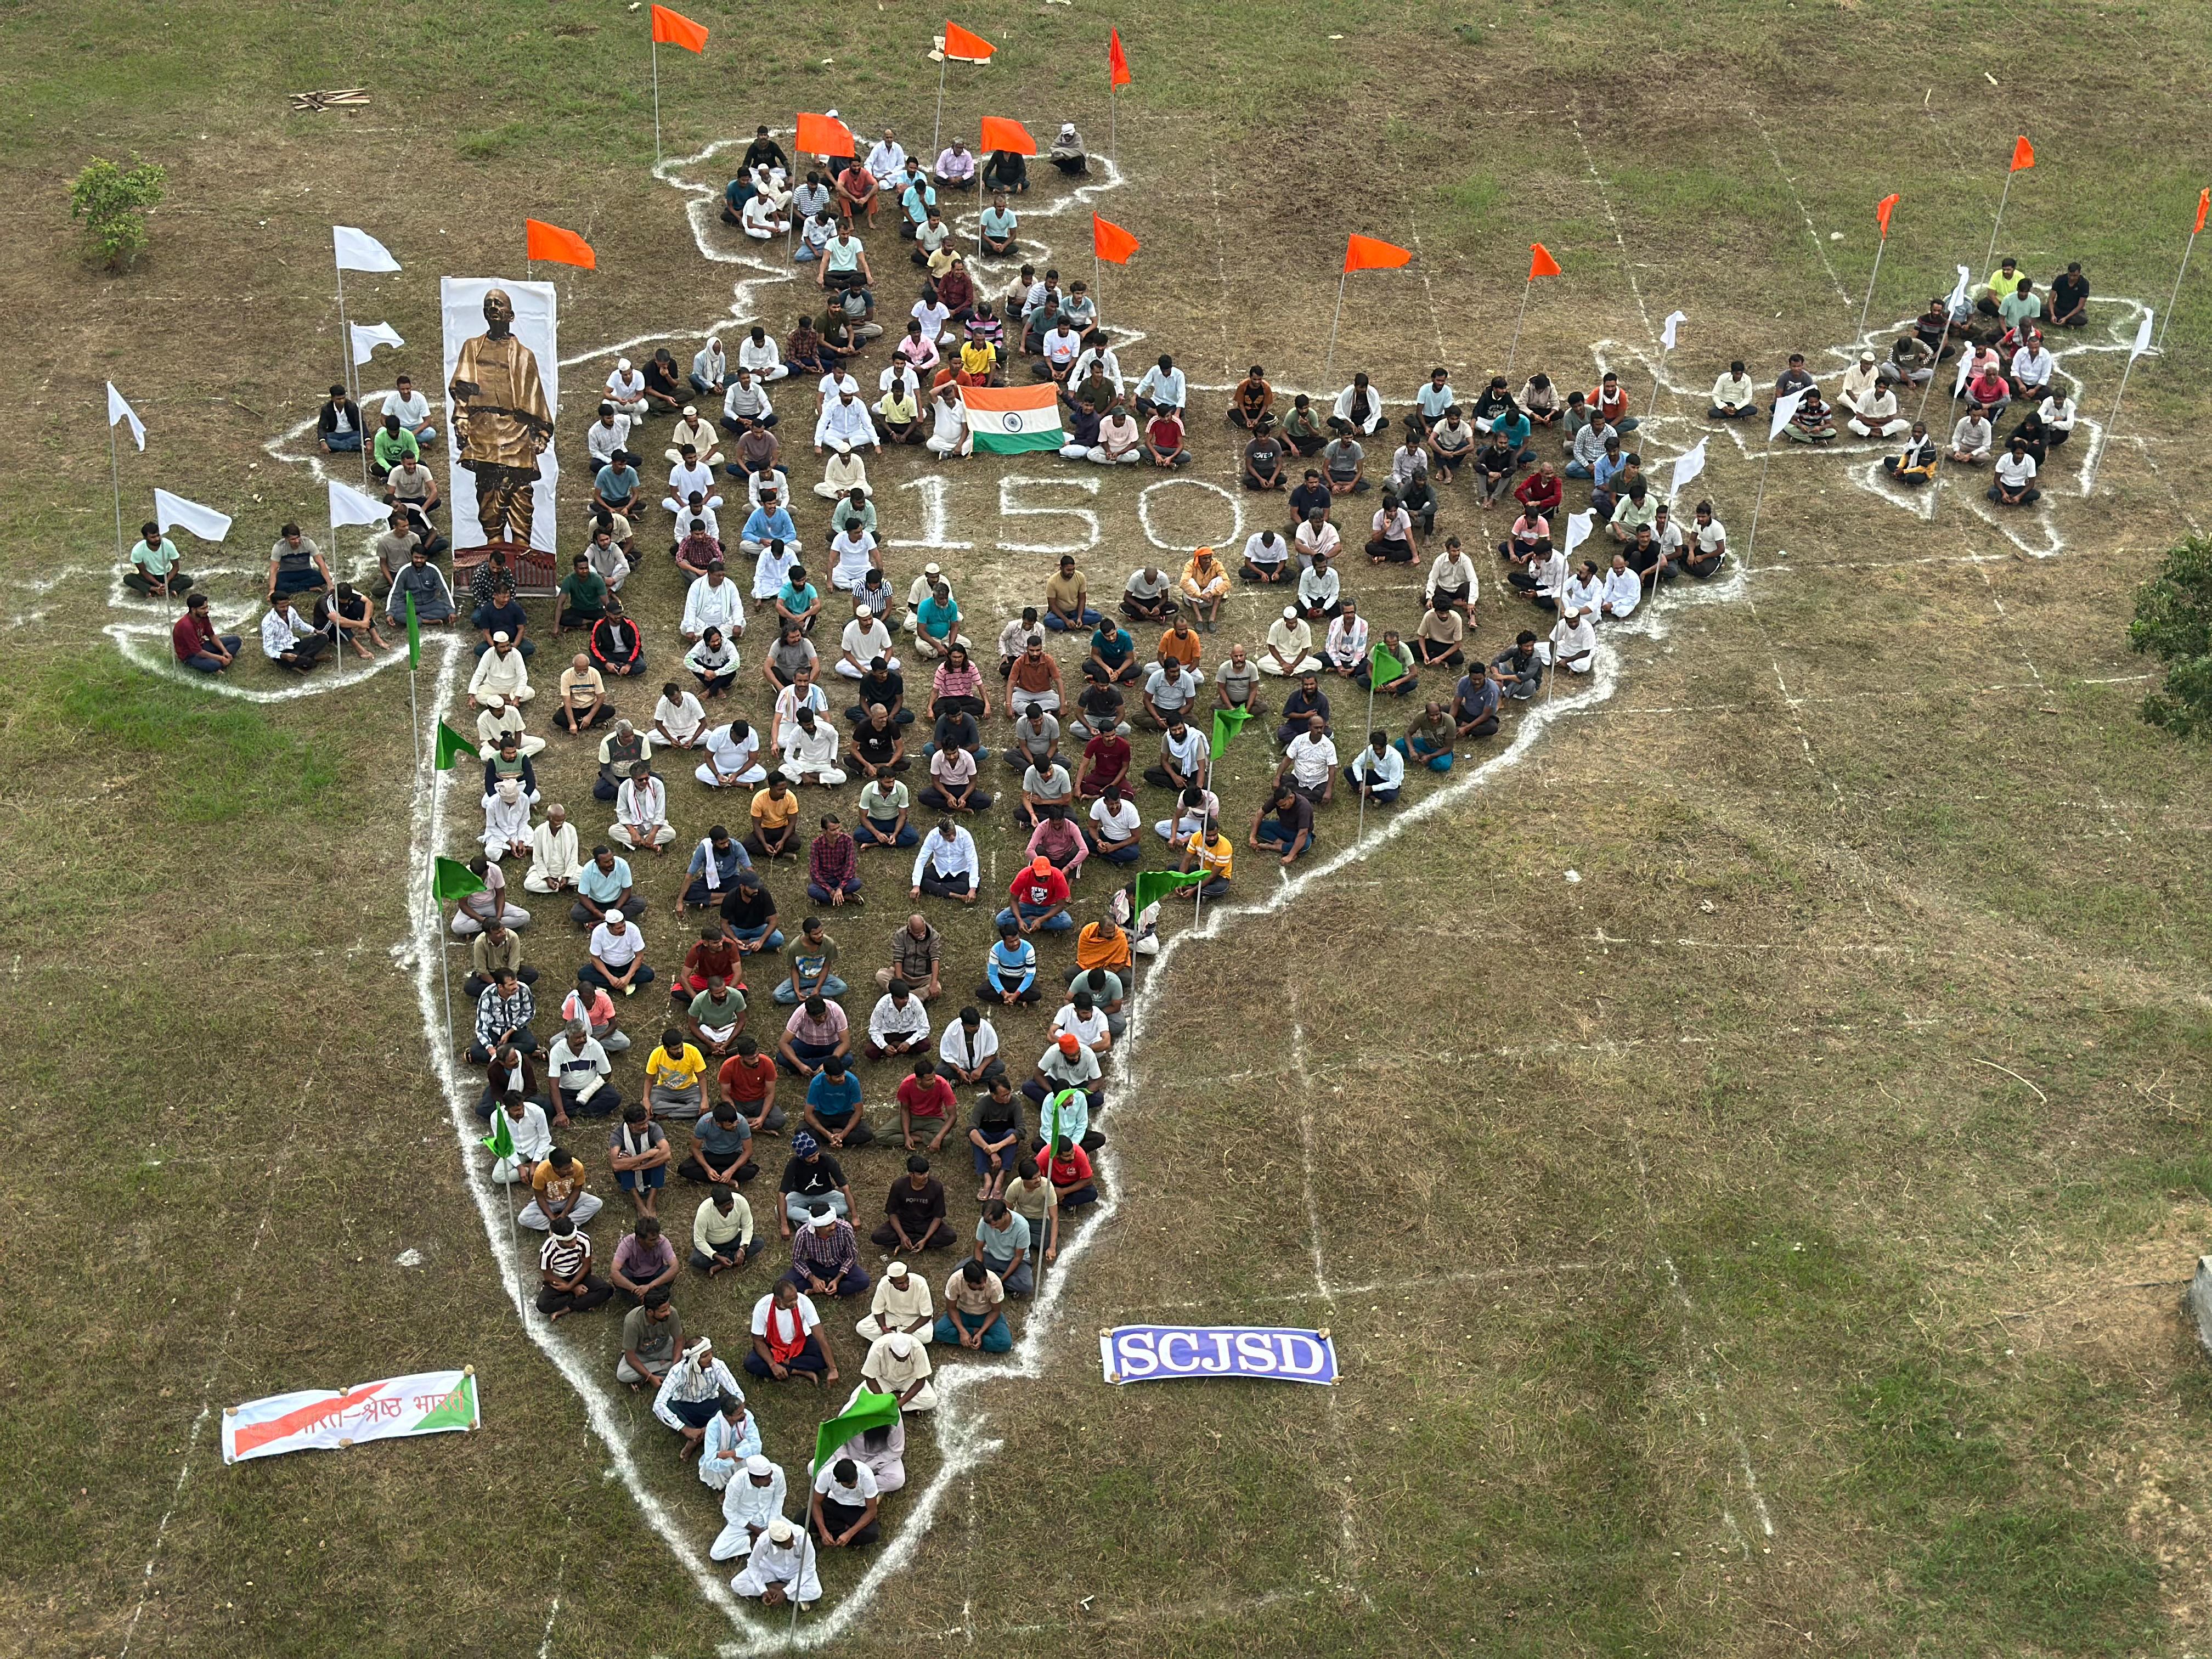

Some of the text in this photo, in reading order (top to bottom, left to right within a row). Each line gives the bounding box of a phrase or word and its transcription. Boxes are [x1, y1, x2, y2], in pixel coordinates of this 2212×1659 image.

[887, 475, 1245, 554] 150
[1118, 1331, 1325, 1377] SCJSD
[413, 1390, 464, 1414] भारत
